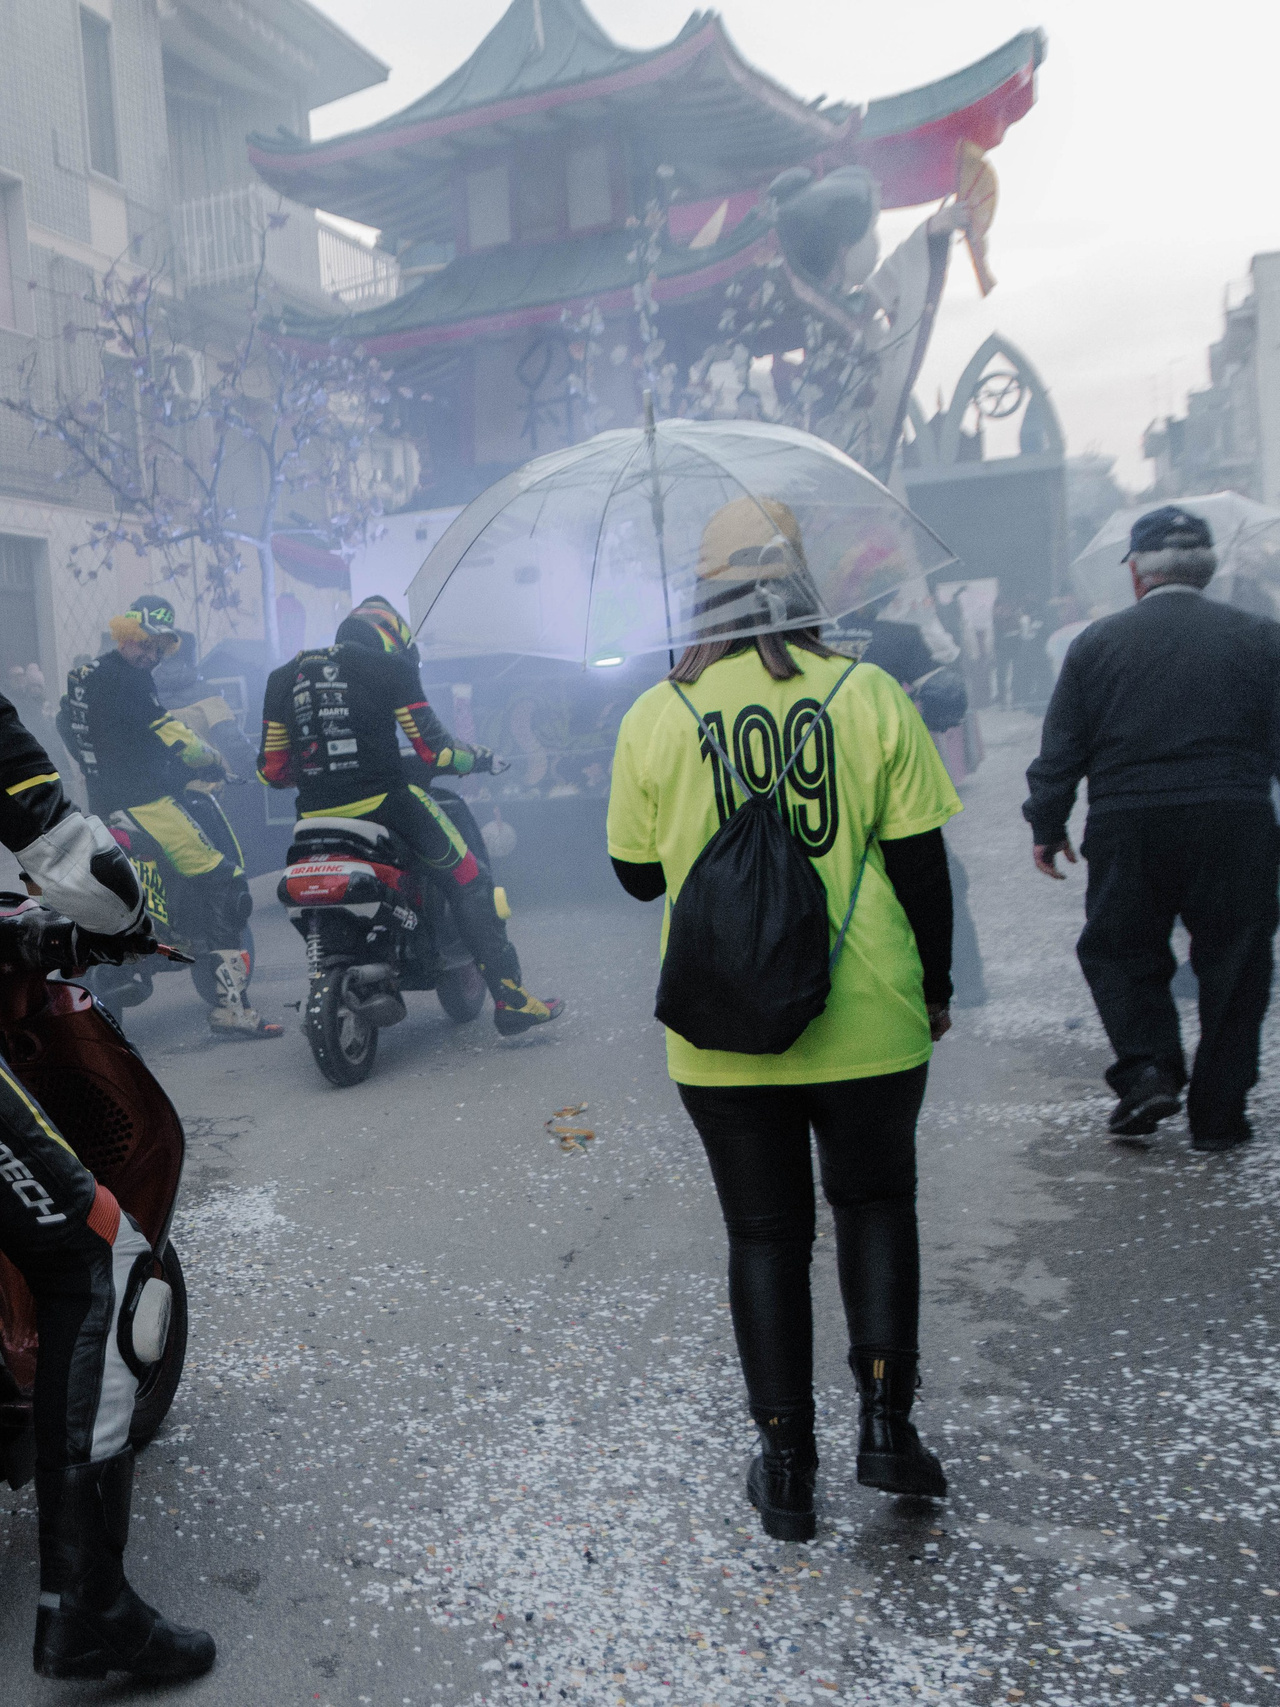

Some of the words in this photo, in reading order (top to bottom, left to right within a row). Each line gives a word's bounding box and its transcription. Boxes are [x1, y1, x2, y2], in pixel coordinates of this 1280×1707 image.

[149, 607, 174, 624] 46
[697, 697, 840, 858] 109
[290, 865, 343, 875] BRAKING
